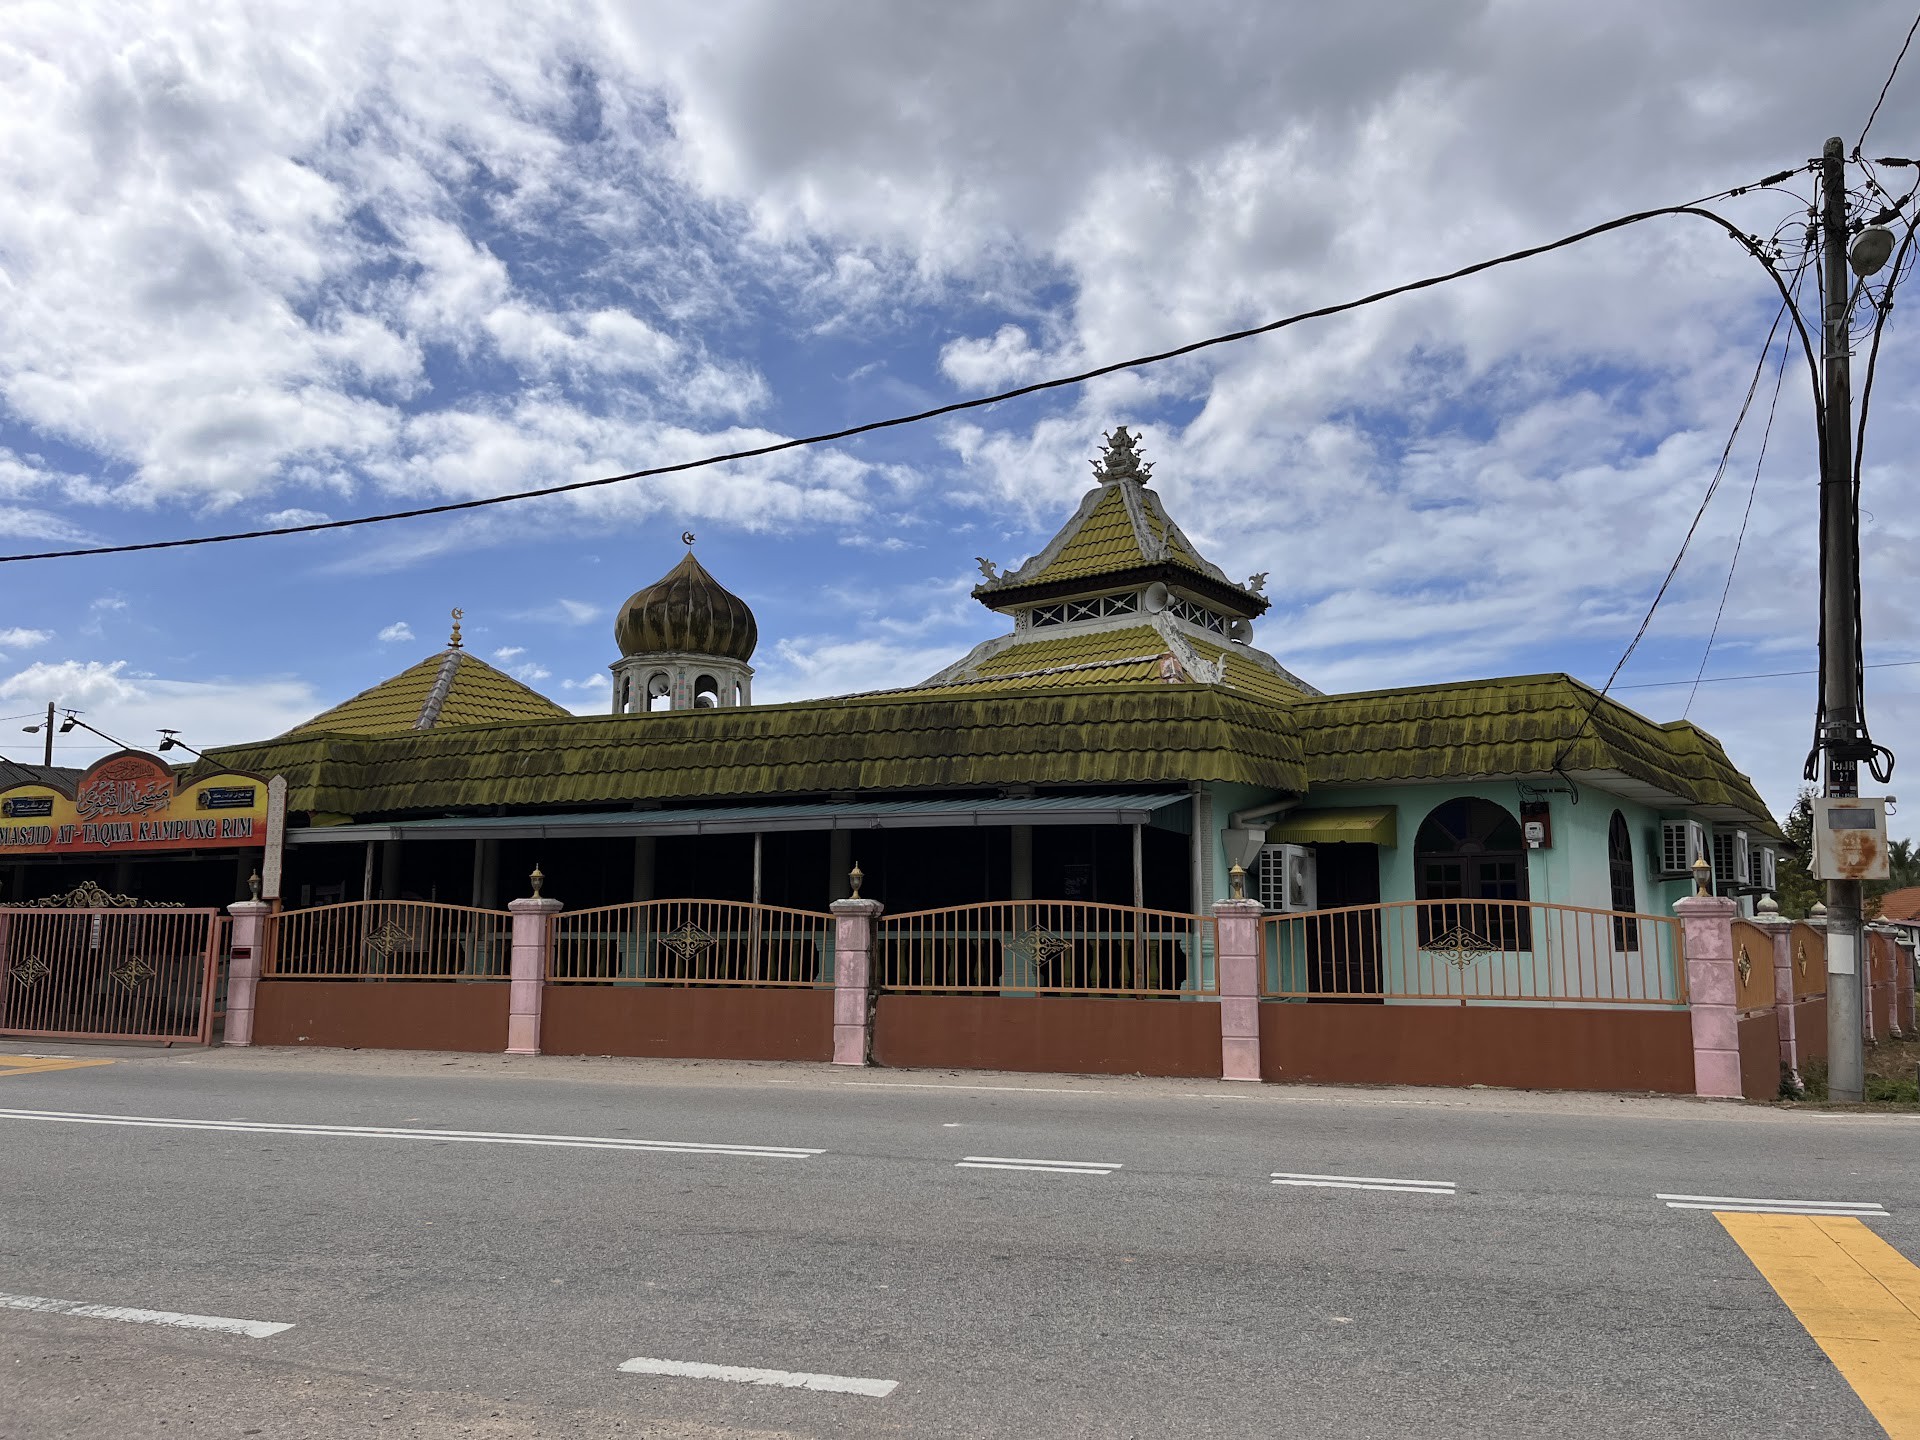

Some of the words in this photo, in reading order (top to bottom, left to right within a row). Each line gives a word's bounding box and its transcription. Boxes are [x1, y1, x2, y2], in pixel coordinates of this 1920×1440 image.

[1839, 772, 1849, 782] 27
[0, 825, 51, 846] MASJID
[55, 820, 134, 847] AT-TAQWA
[138, 818, 217, 841] KAMPUNG
[220, 816, 253, 839] RIM
